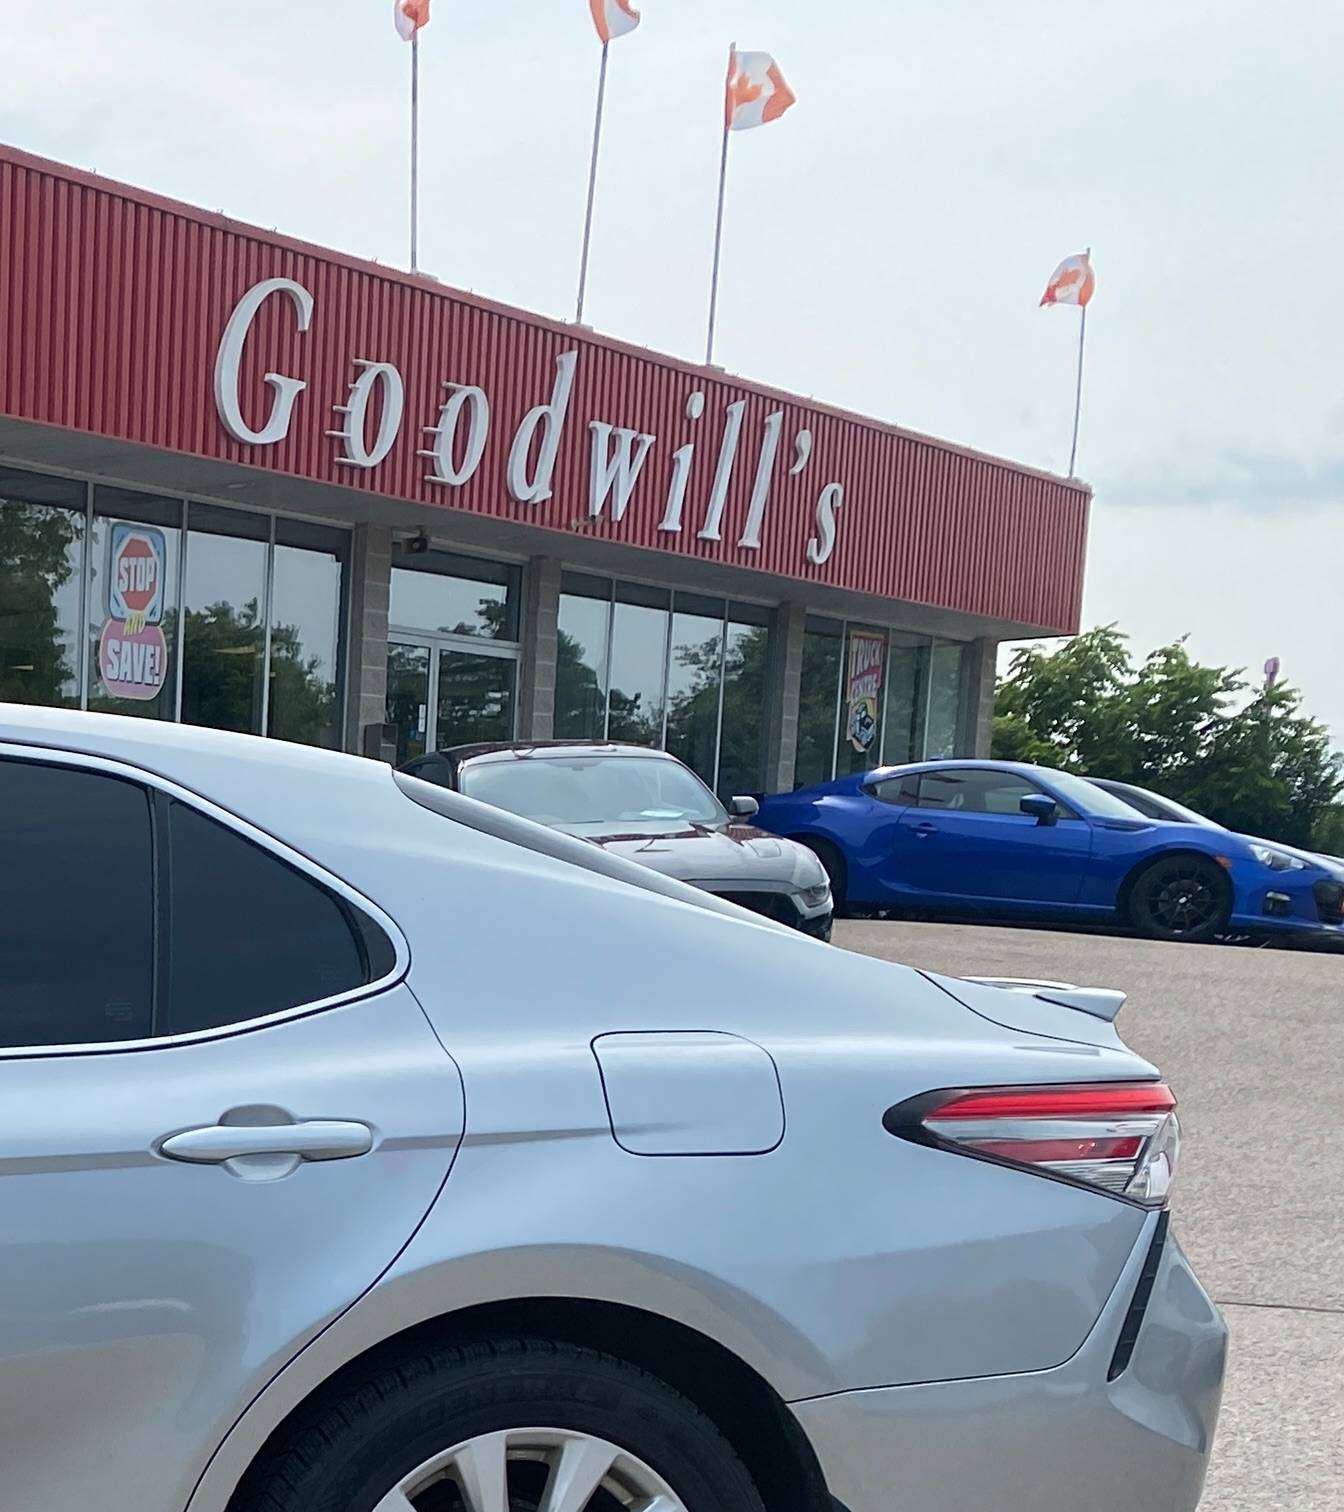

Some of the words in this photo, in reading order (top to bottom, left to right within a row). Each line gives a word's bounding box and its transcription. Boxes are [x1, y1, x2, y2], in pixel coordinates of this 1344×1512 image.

[213, 276, 845, 566] Goodwill's
[118, 556, 158, 593] STOP
[106, 638, 162, 687] SAVE!
[851, 637, 883, 680] TRUCK
